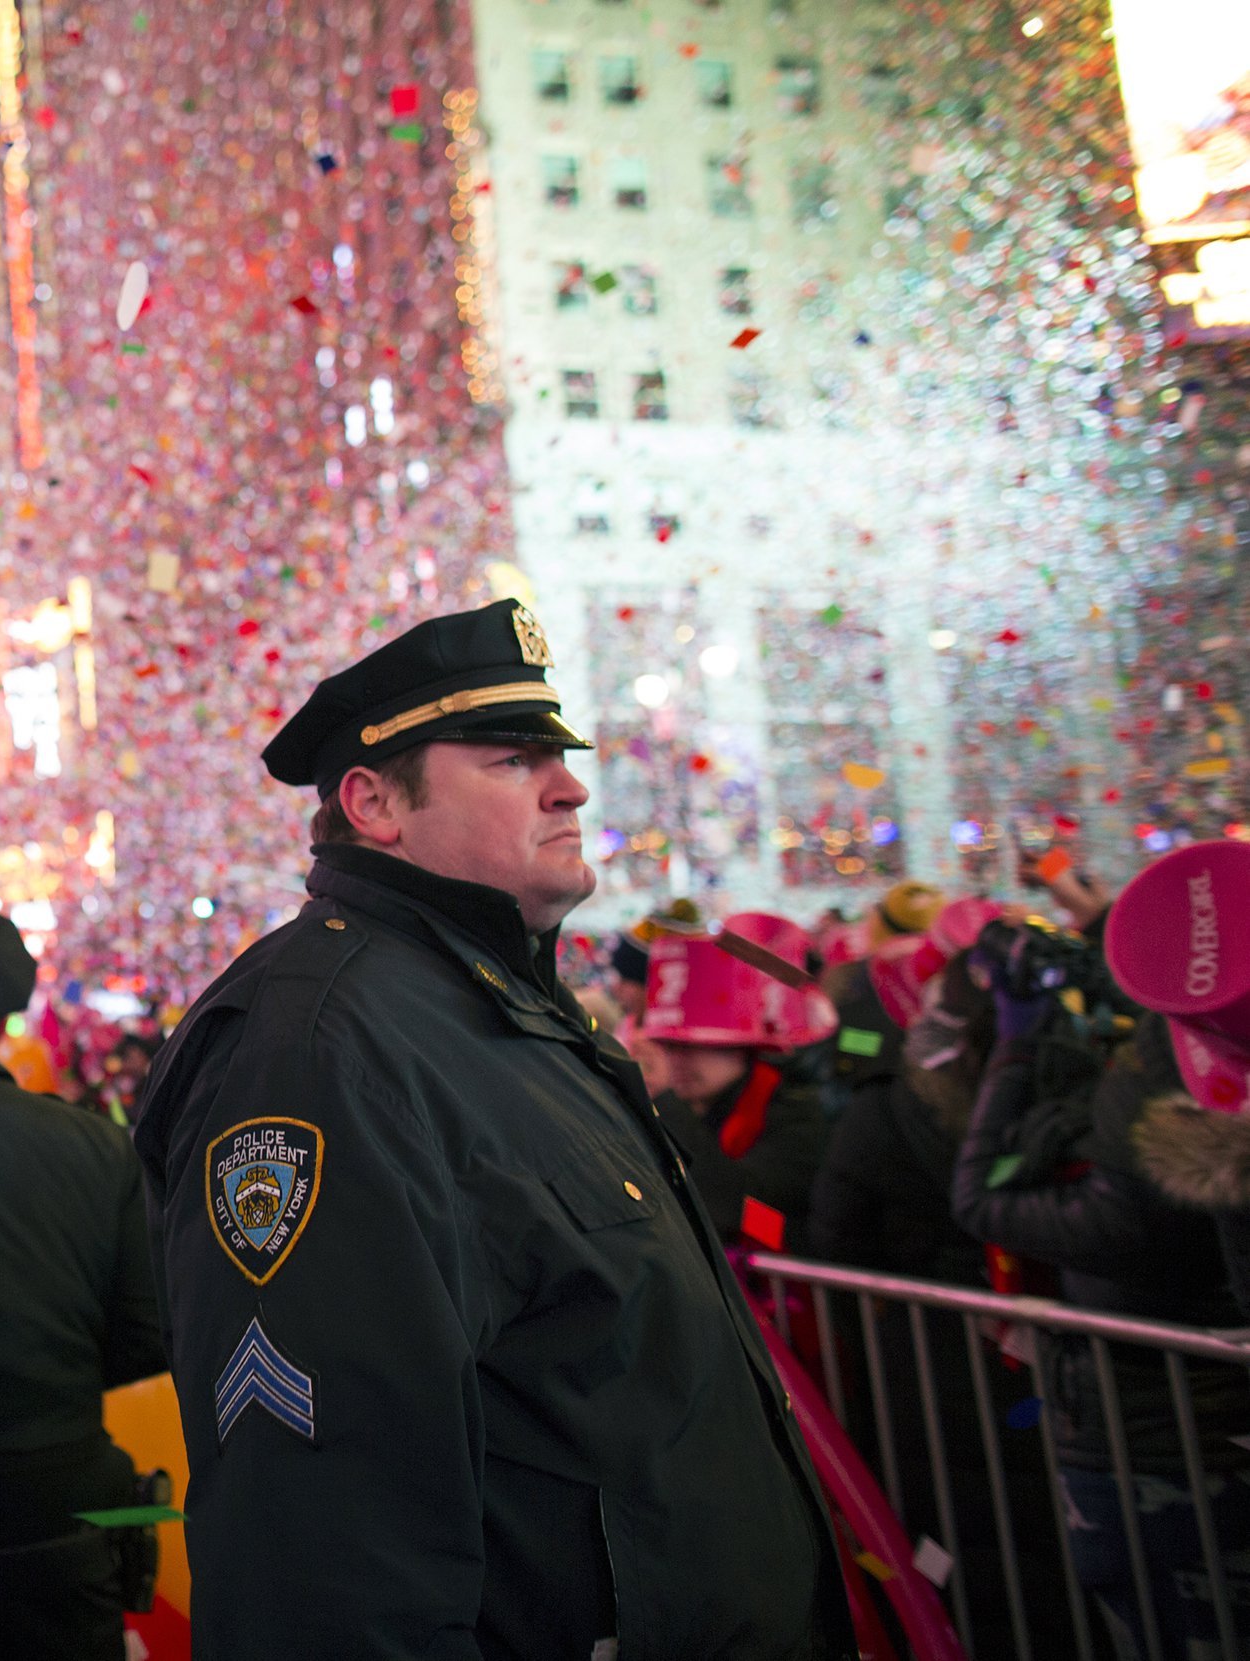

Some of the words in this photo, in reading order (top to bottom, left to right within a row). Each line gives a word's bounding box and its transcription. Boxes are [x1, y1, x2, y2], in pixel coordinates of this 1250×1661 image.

[216, 1145, 308, 1179] DEPARTMENT
[233, 1129, 286, 1152] POLICE
[216, 1195, 234, 1230] CITY
[231, 1231, 248, 1250] OF
[265, 1221, 290, 1255] NEW
[285, 1177, 309, 1219] YORK
